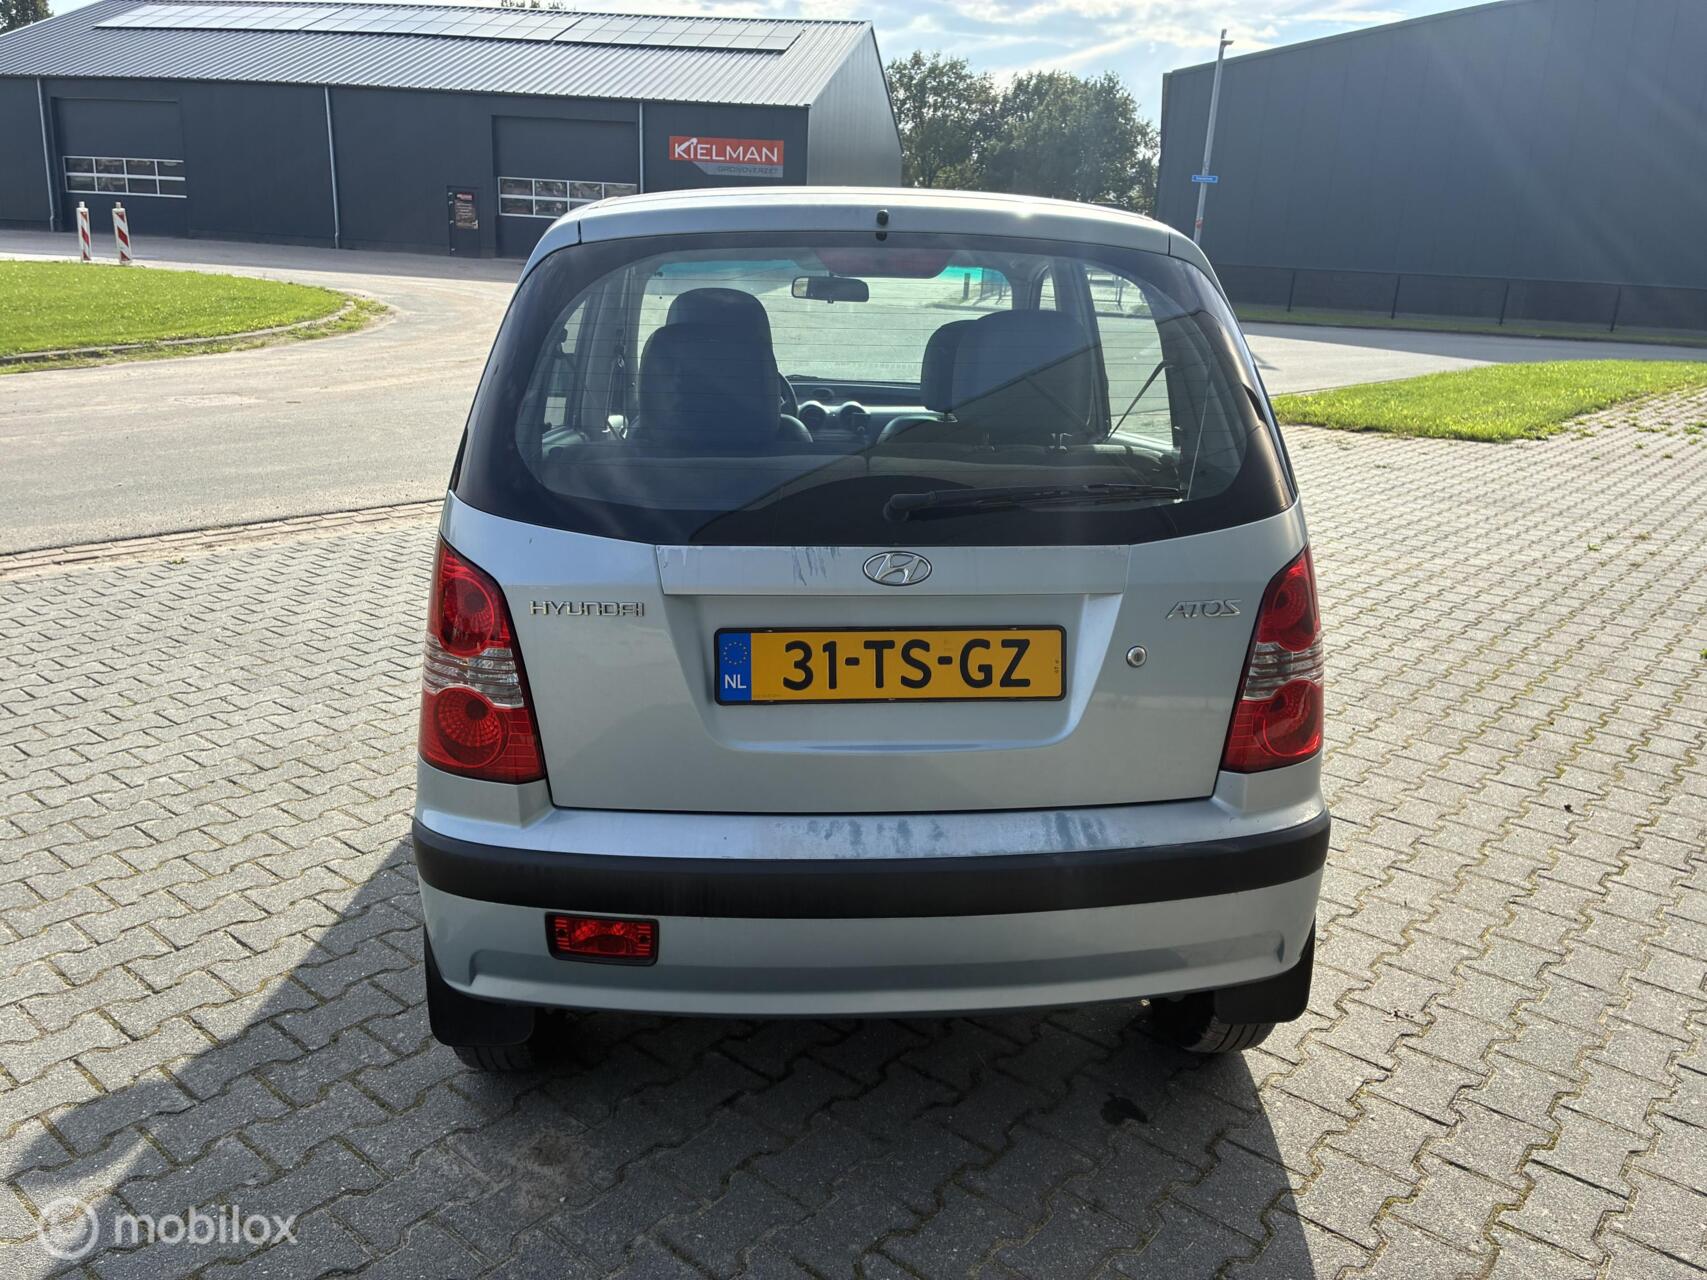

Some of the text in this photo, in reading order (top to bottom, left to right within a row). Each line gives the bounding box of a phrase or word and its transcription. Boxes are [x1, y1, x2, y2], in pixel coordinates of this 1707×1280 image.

[674, 138, 779, 162] KIELMAN
[529, 600, 645, 617] HYUNDAI
[1165, 599, 1242, 620] ATOS
[782, 638, 1032, 691] 31-TS-GZ
[724, 674, 747, 689] NL
